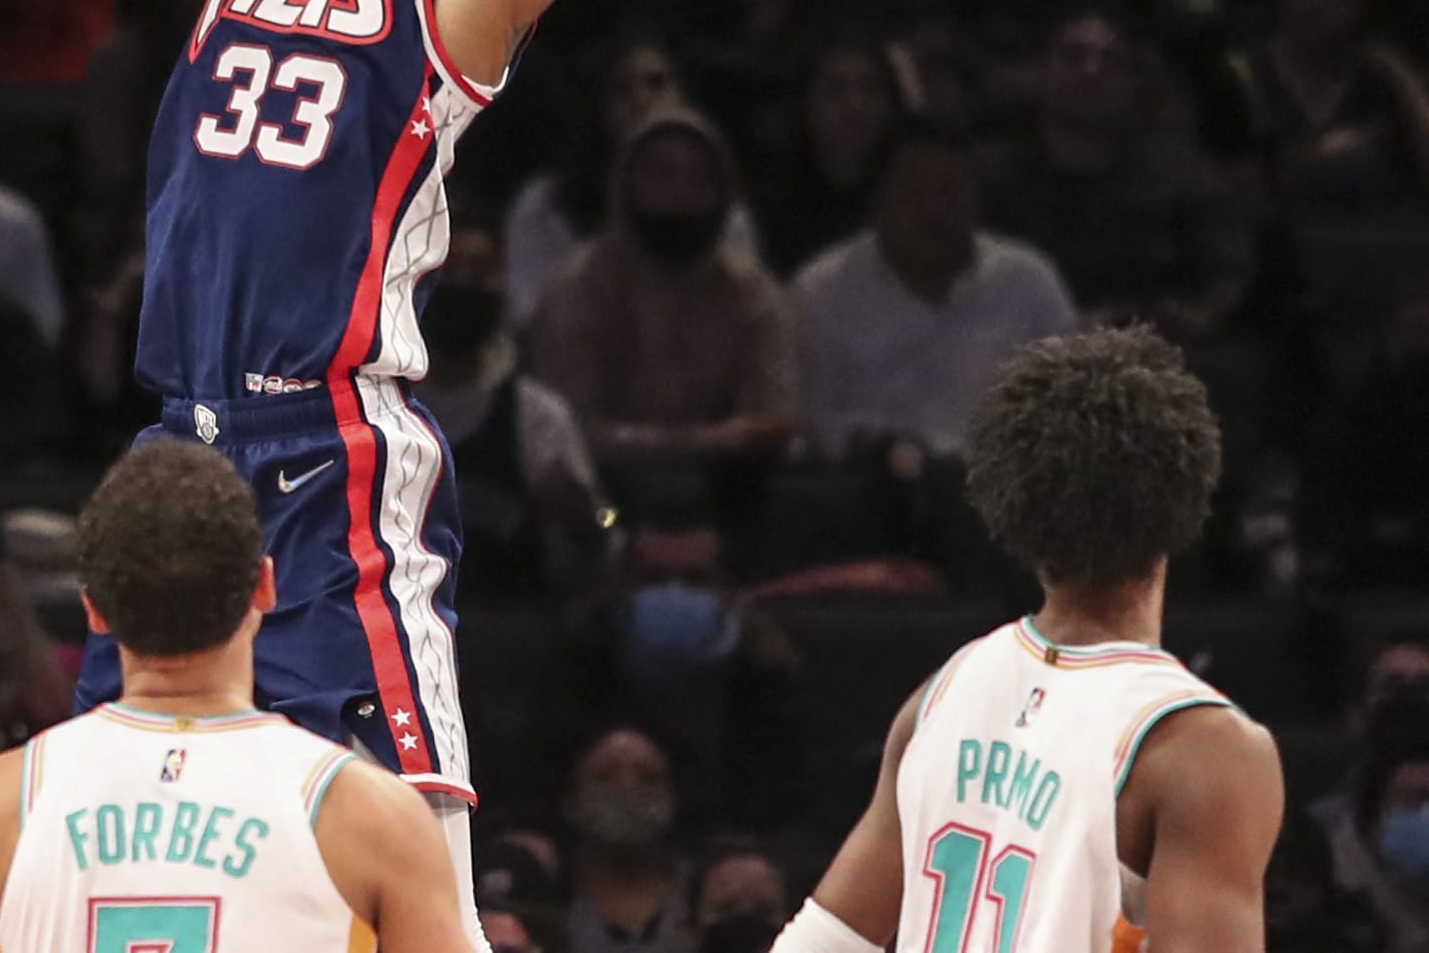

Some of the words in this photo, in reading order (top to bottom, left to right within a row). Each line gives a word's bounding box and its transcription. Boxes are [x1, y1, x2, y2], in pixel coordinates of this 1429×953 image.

[193, 42, 347, 170] 33
[65, 800, 270, 879] FORBES
[923, 821, 1037, 953] 11
